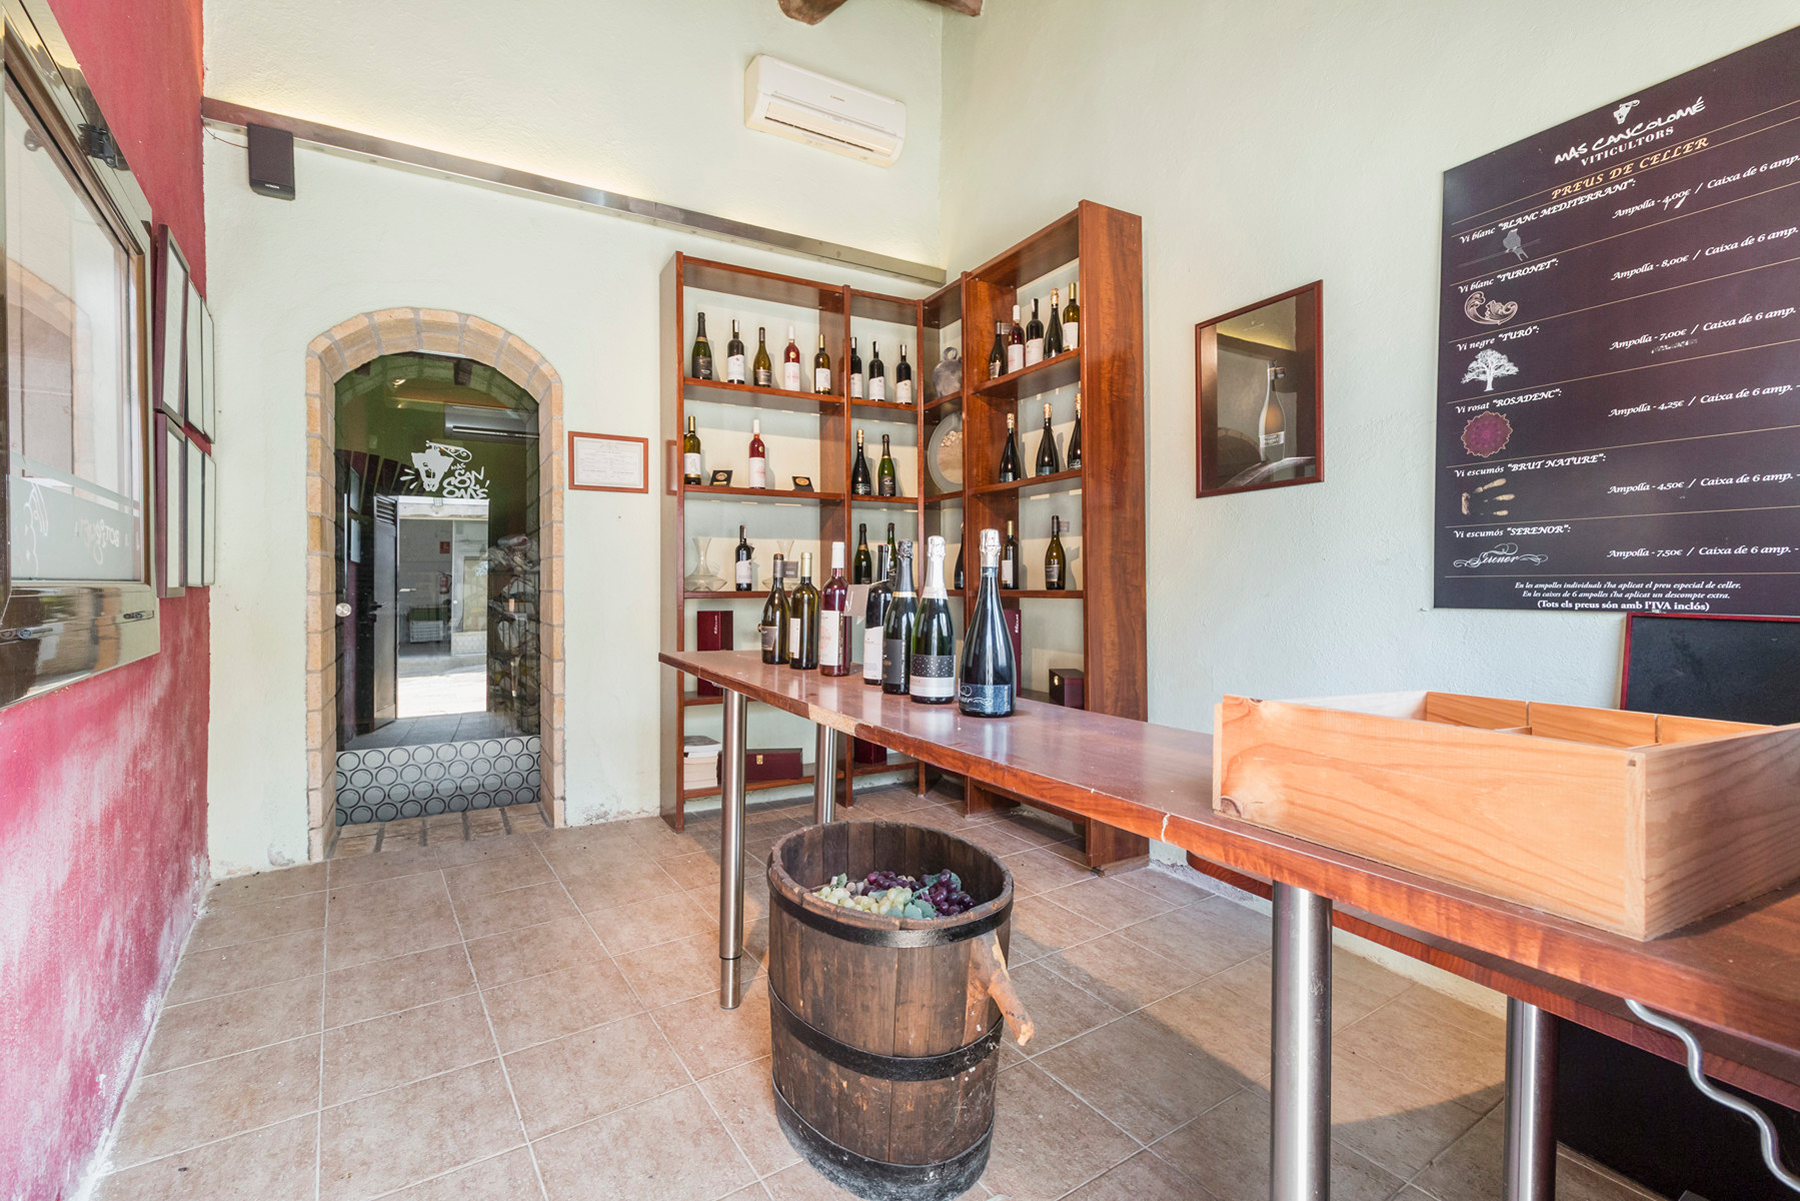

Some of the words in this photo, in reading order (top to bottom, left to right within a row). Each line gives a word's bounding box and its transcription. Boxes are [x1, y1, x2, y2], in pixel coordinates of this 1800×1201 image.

[1554, 142, 1588, 164] MAS
[1580, 126, 1674, 166] VITICULTORS
[1551, 173, 1604, 200] PREUS
[1609, 162, 1634, 180] DE
[1639, 137, 1710, 169] CELLER
[1612, 198, 1656, 218] Ampolla
[1694, 182, 1704, 194] /
[1707, 172, 1740, 189] Caixa
[1742, 165, 1757, 177] de
[1759, 164, 1768, 172] 6
[1459, 234, 1470, 244] Vi
[1471, 227, 1496, 240] blanc
[1610, 262, 1654, 280] Ampolla
[1692, 249, 1702, 261] /
[1705, 241, 1738, 256] Caixa
[1740, 234, 1755, 246] de
[1757, 234, 1765, 242] 6
[1768, 226, 1799, 240] amp.
[1458, 285, 1468, 294] Vi
[1470, 278, 1494, 291] blanc
[1609, 334, 1652, 350] Ampolla
[1690, 324, 1700, 335] /
[1702, 319, 1736, 331] Caixa
[1738, 313, 1752, 324] de
[1755, 311, 1763, 320] 6
[1765, 306, 1796, 318] amp.
[1456, 343, 1467, 352] Vi
[1469, 338, 1496, 351] negre
[1608, 402, 1651, 417] Ampolla
[1688, 396, 1696, 406] /
[1700, 392, 1733, 404] Caixa
[1735, 388, 1750, 399] de
[1752, 387, 1760, 396] 6
[1762, 382, 1793, 396] amp.
[1455, 406, 1466, 414] Vi
[1467, 402, 1490, 412] rosat
[1454, 469, 1465, 478] Vi
[1466, 465, 1505, 477] escumós
[1607, 482, 1650, 495] Ampolla
[1688, 478, 1697, 489] /
[1700, 476, 1734, 486] Caixa
[1735, 474, 1750, 483] de
[1752, 473, 1760, 483] 6
[1762, 472, 1794, 484] amp.
[1453, 530, 1465, 538] Vi
[1466, 528, 1504, 538] escumós
[1606, 548, 1650, 560] Ampolla
[1686, 546, 1695, 556] /
[1698, 546, 1732, 556] Caixa
[1734, 545, 1748, 555] de
[1750, 545, 1759, 554] 6
[1760, 545, 1792, 556] amp.
[1534, 581, 1562, 590] ampolles
[1563, 581, 1601, 589] individuals
[1618, 581, 1644, 590] aplicat
[1645, 581, 1653, 589] el
[1673, 581, 1704, 590] especial
[1705, 581, 1716, 589] de
[1717, 581, 1741, 589] celler.
[1578, 590, 1608, 599] ampolles
[1624, 591, 1650, 600] aplicat
[1664, 591, 1706, 600] descompte
[1537, 600, 1559, 609] (Tots
[1574, 602, 1600, 610] preus
[1601, 600, 1618, 609] són
[1620, 601, 1643, 610] amb
[1673, 601, 1710, 612] inclós)
